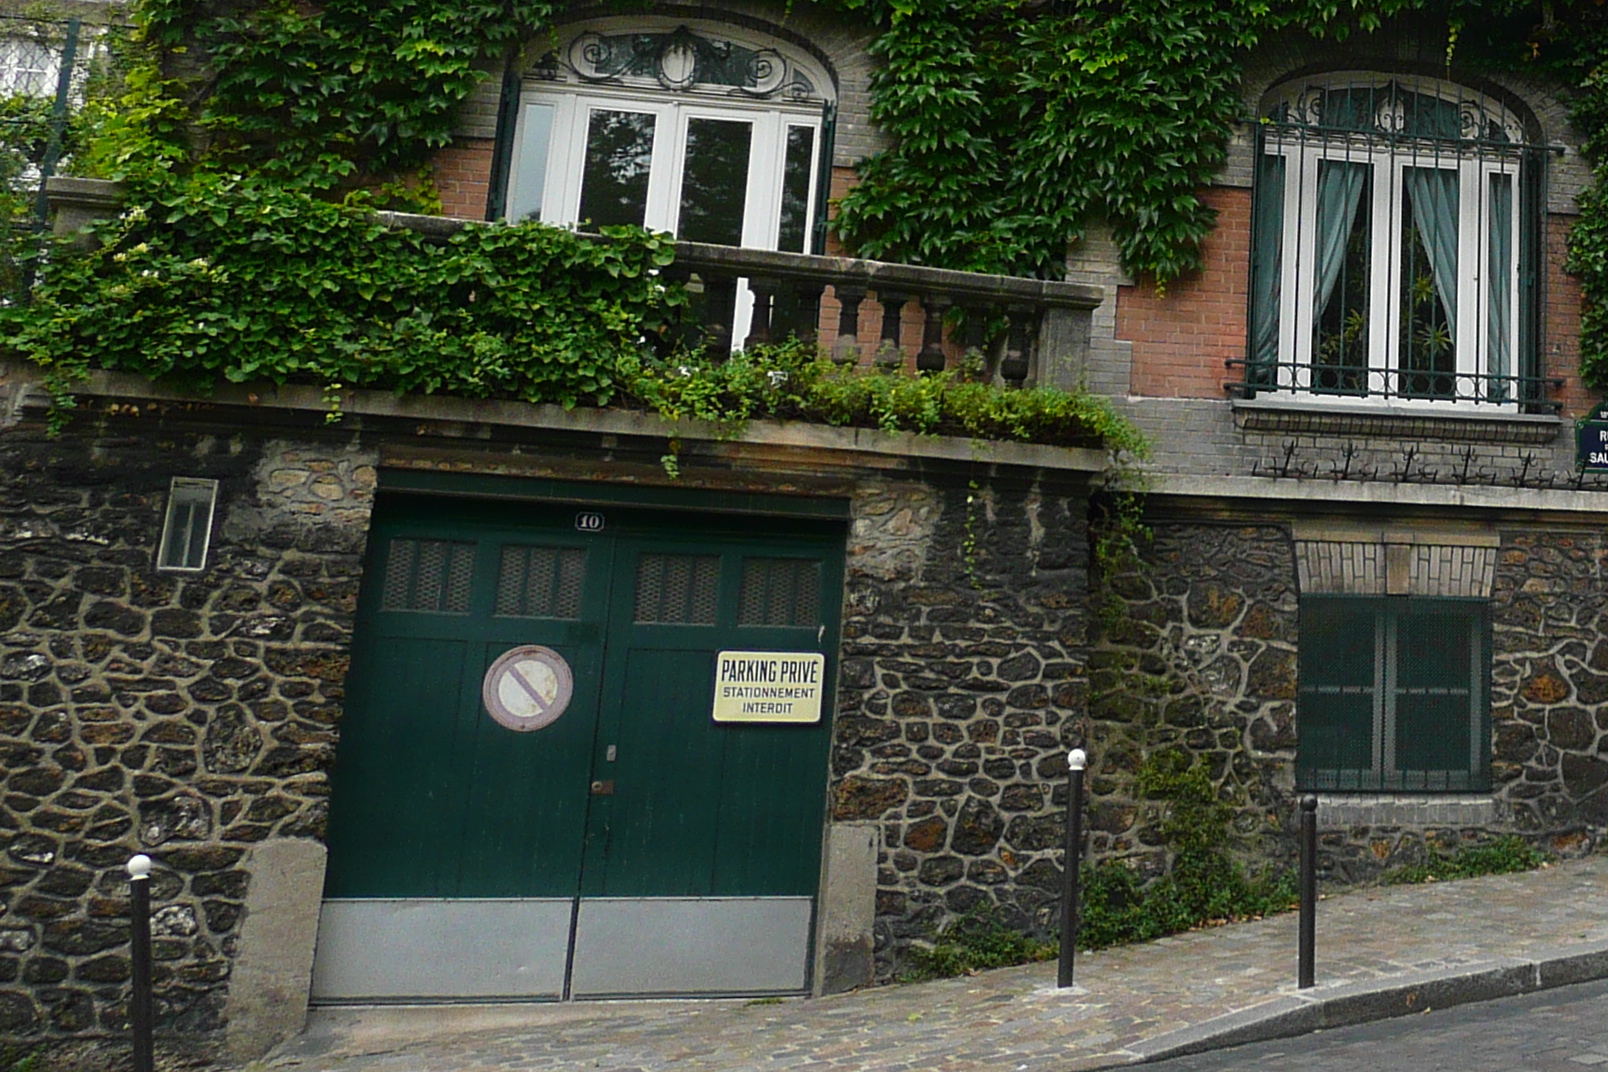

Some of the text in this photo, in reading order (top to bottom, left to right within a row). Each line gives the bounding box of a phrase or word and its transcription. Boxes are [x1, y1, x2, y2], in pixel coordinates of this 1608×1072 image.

[580, 515, 600, 529] 10
[721, 659, 819, 684] PARKING PRIVÉ
[723, 686, 815, 699] STATIONNEMENT
[742, 702, 794, 714] INTERDIT
